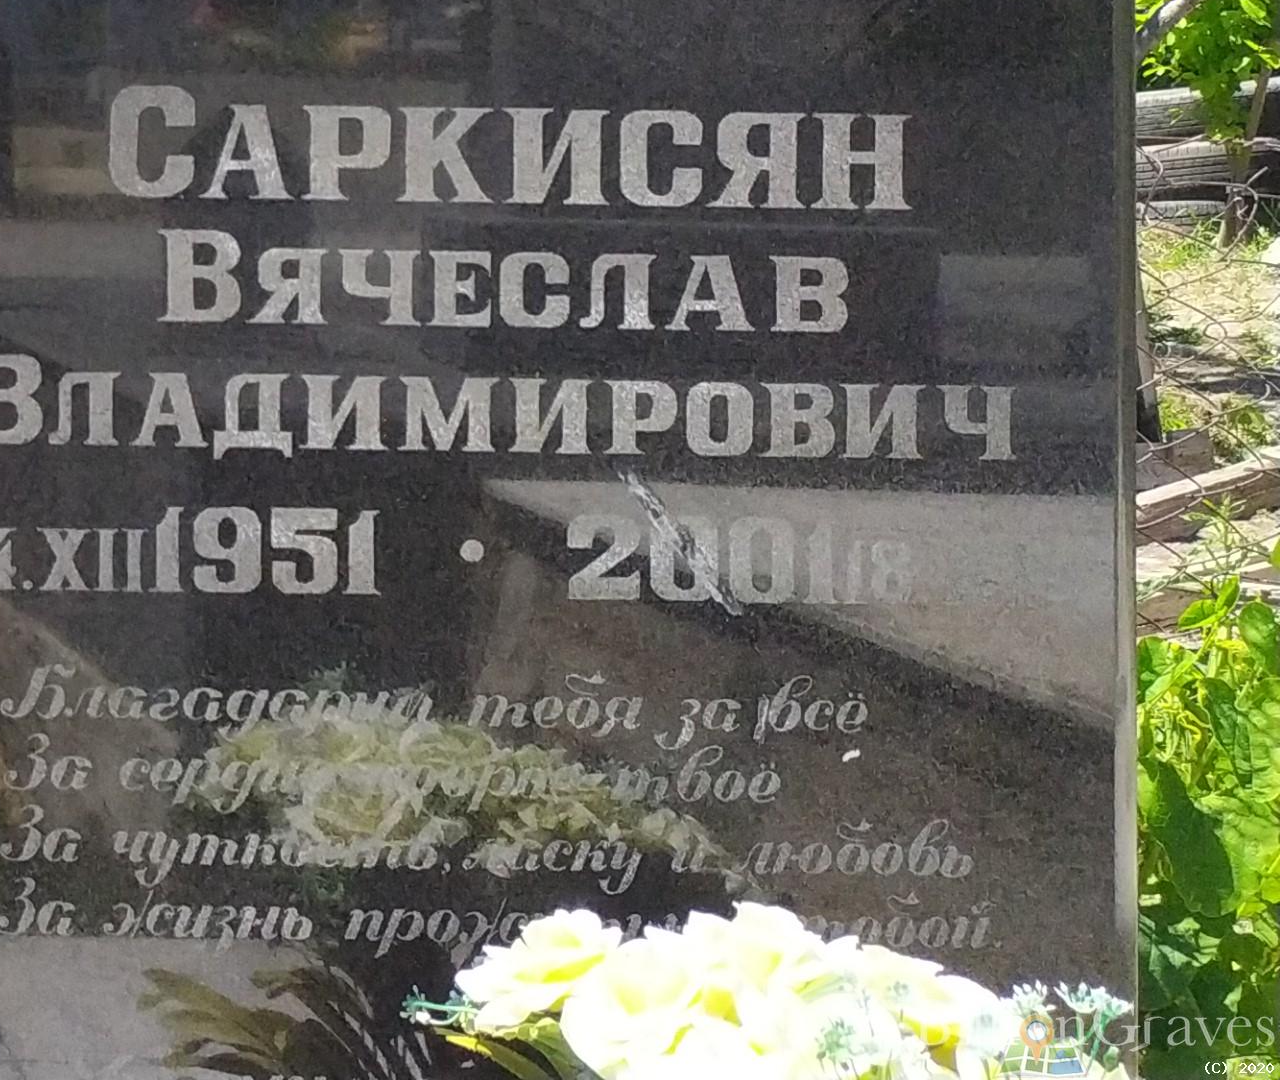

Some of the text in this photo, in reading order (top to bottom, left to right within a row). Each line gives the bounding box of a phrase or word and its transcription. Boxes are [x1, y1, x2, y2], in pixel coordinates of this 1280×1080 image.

[466, 671, 643, 737] тебя
[654, 697, 741, 750] за
[4, 733, 92, 790] За
[608, 745, 782, 804] твоё
[0, 804, 82, 862] За
[740, 819, 973, 879] любовь
[103, 890, 313, 955] жизнь
